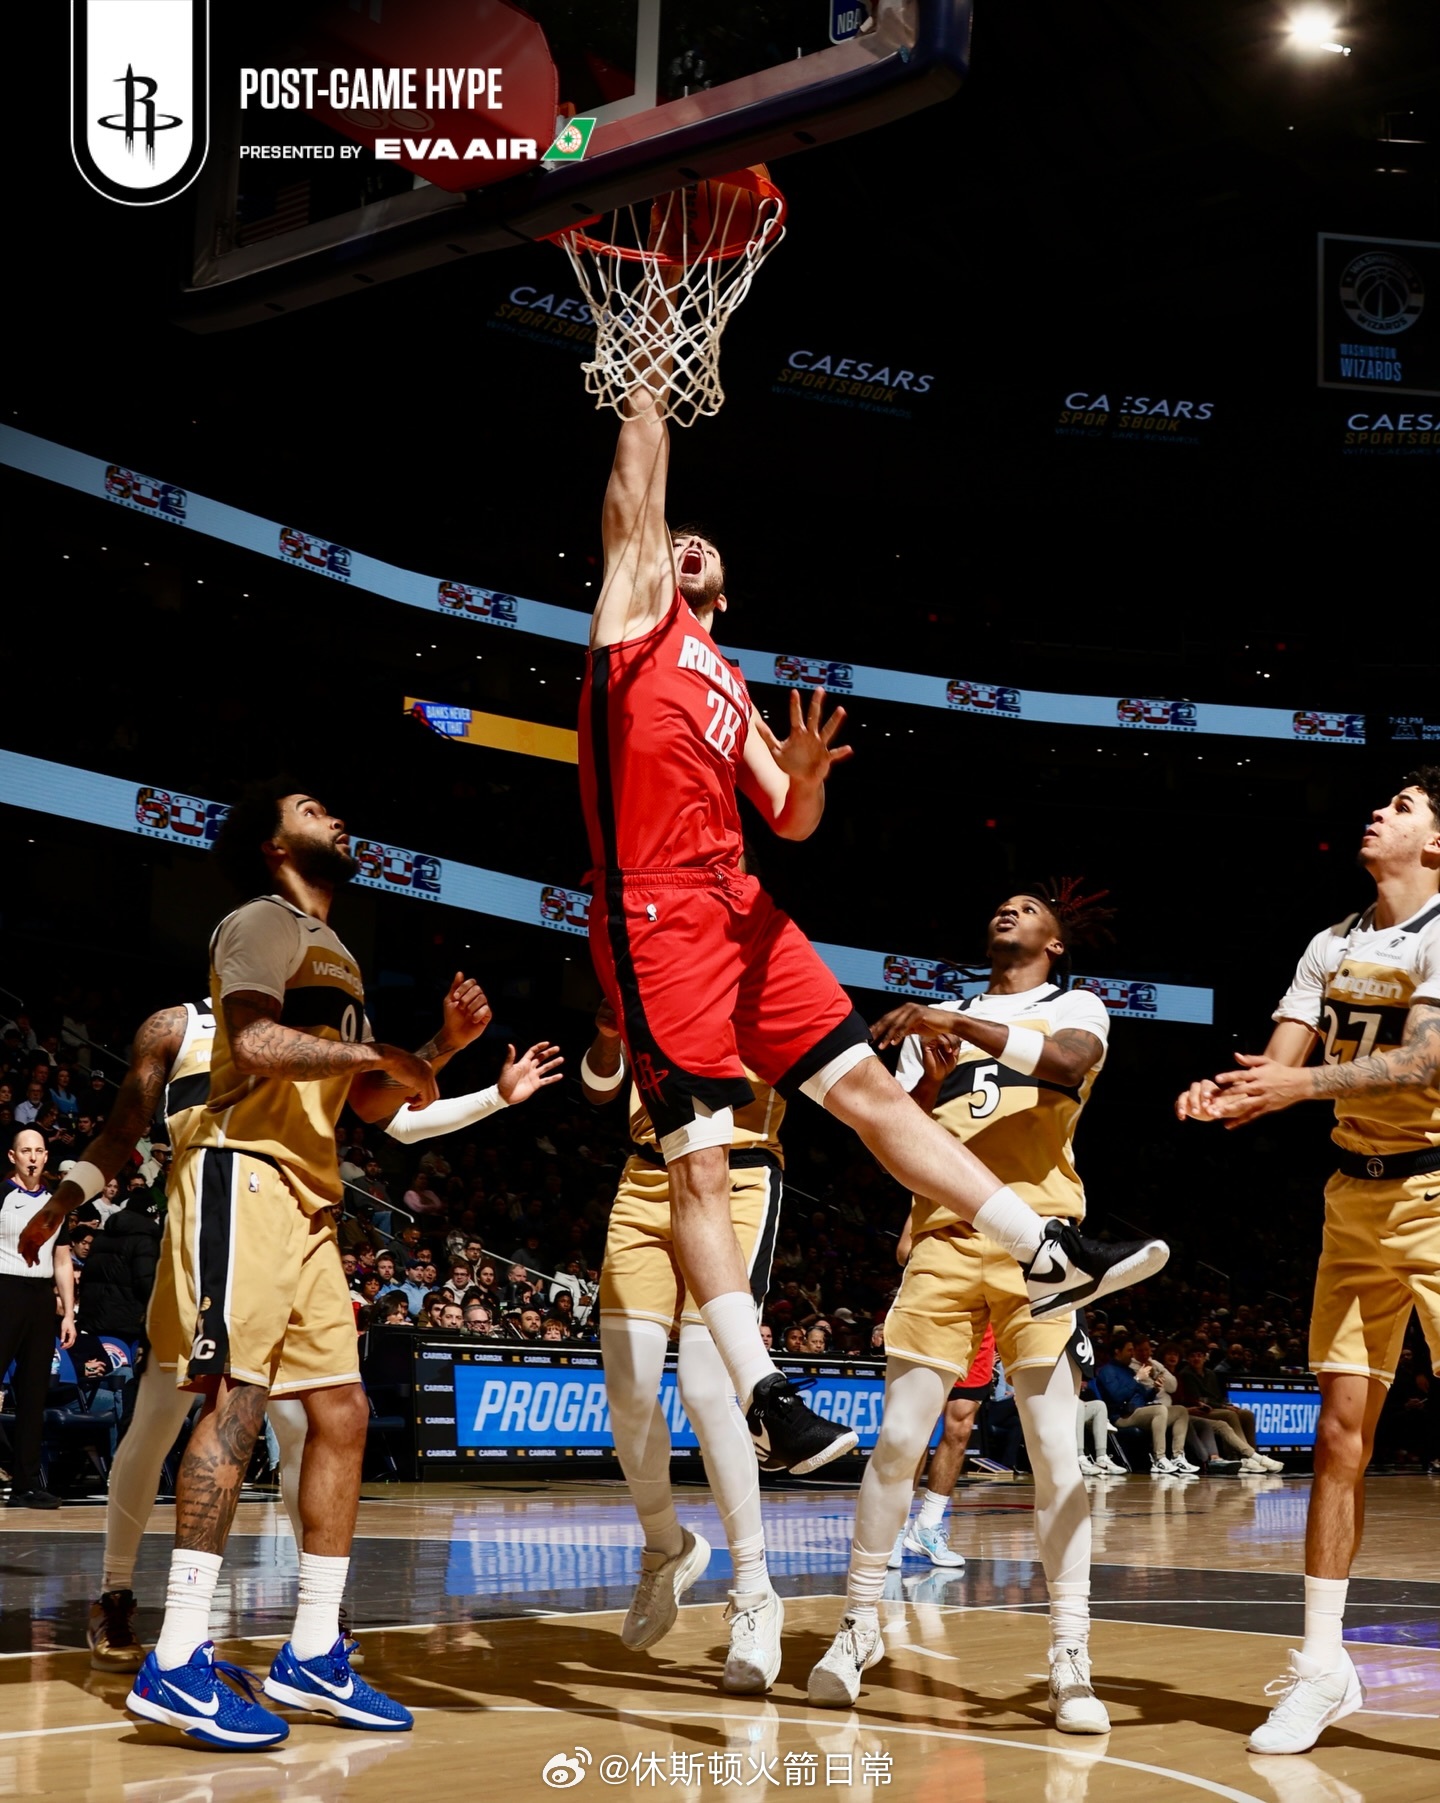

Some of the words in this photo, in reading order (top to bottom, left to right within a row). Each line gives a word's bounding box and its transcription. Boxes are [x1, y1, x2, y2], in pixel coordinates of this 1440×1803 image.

[837, 8, 861, 35] NBA
[495, 303, 598, 344] SPORTSBOO
[509, 285, 634, 327] CAES
[777, 368, 899, 403] SPORTSBOOK
[788, 350, 936, 393] CAESARS
[1340, 358, 1403, 383] WIZARDS
[1059, 411, 1181, 432] SPORSBOOK
[105, 465, 188, 519] 602
[280, 527, 352, 577] 602
[438, 581, 518, 623] 602
[677, 634, 751, 722] ROCKE
[775, 655, 854, 689] 602
[947, 680, 1021, 713] 602
[1117, 700, 1197, 727] 602
[704, 688, 743, 763] 28
[1409, 716, 1425, 725] PM
[136, 826, 210, 849] STEAMFITT
[354, 840, 442, 894] 602
[355, 876, 440, 903] STEAMFITTERS
[540, 886, 593, 928] 60
[541, 919, 590, 936] STEAMFIT
[884, 984, 955, 1000] STEAMFITTER
[1323, 1005, 1382, 1066] 27
[968, 1062, 1002, 1120] 5
